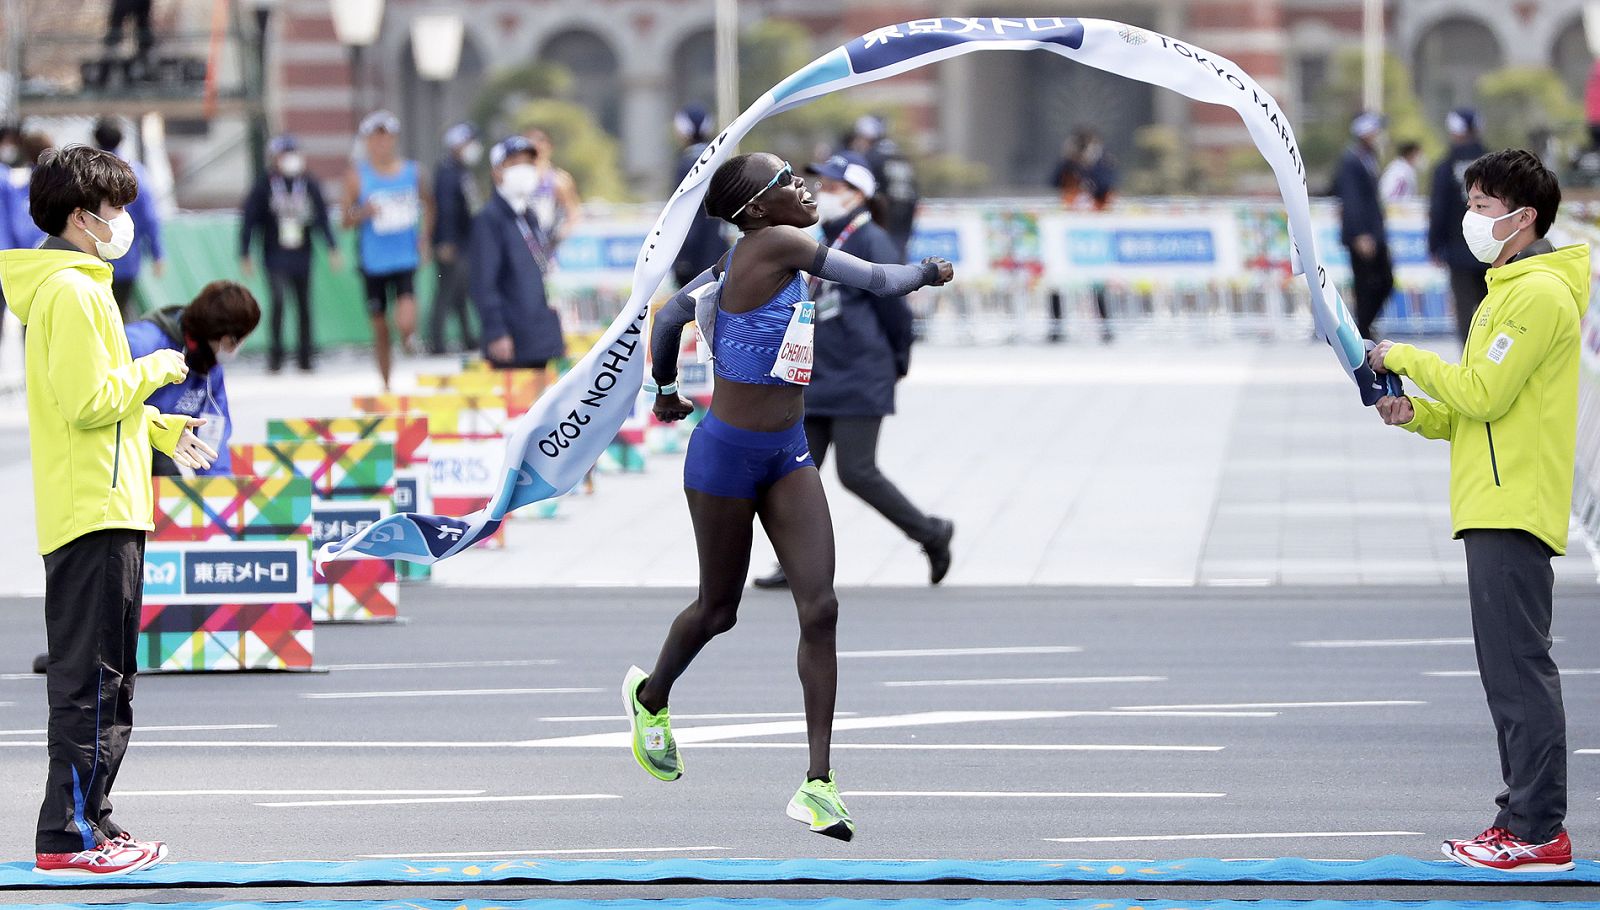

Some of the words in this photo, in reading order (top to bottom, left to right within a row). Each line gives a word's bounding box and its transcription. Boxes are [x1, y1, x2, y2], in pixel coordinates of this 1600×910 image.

[1155, 34, 1245, 91] TOKYO
[538, 409, 591, 458] 2020
[194, 562, 288, 584] 東京メトロ
